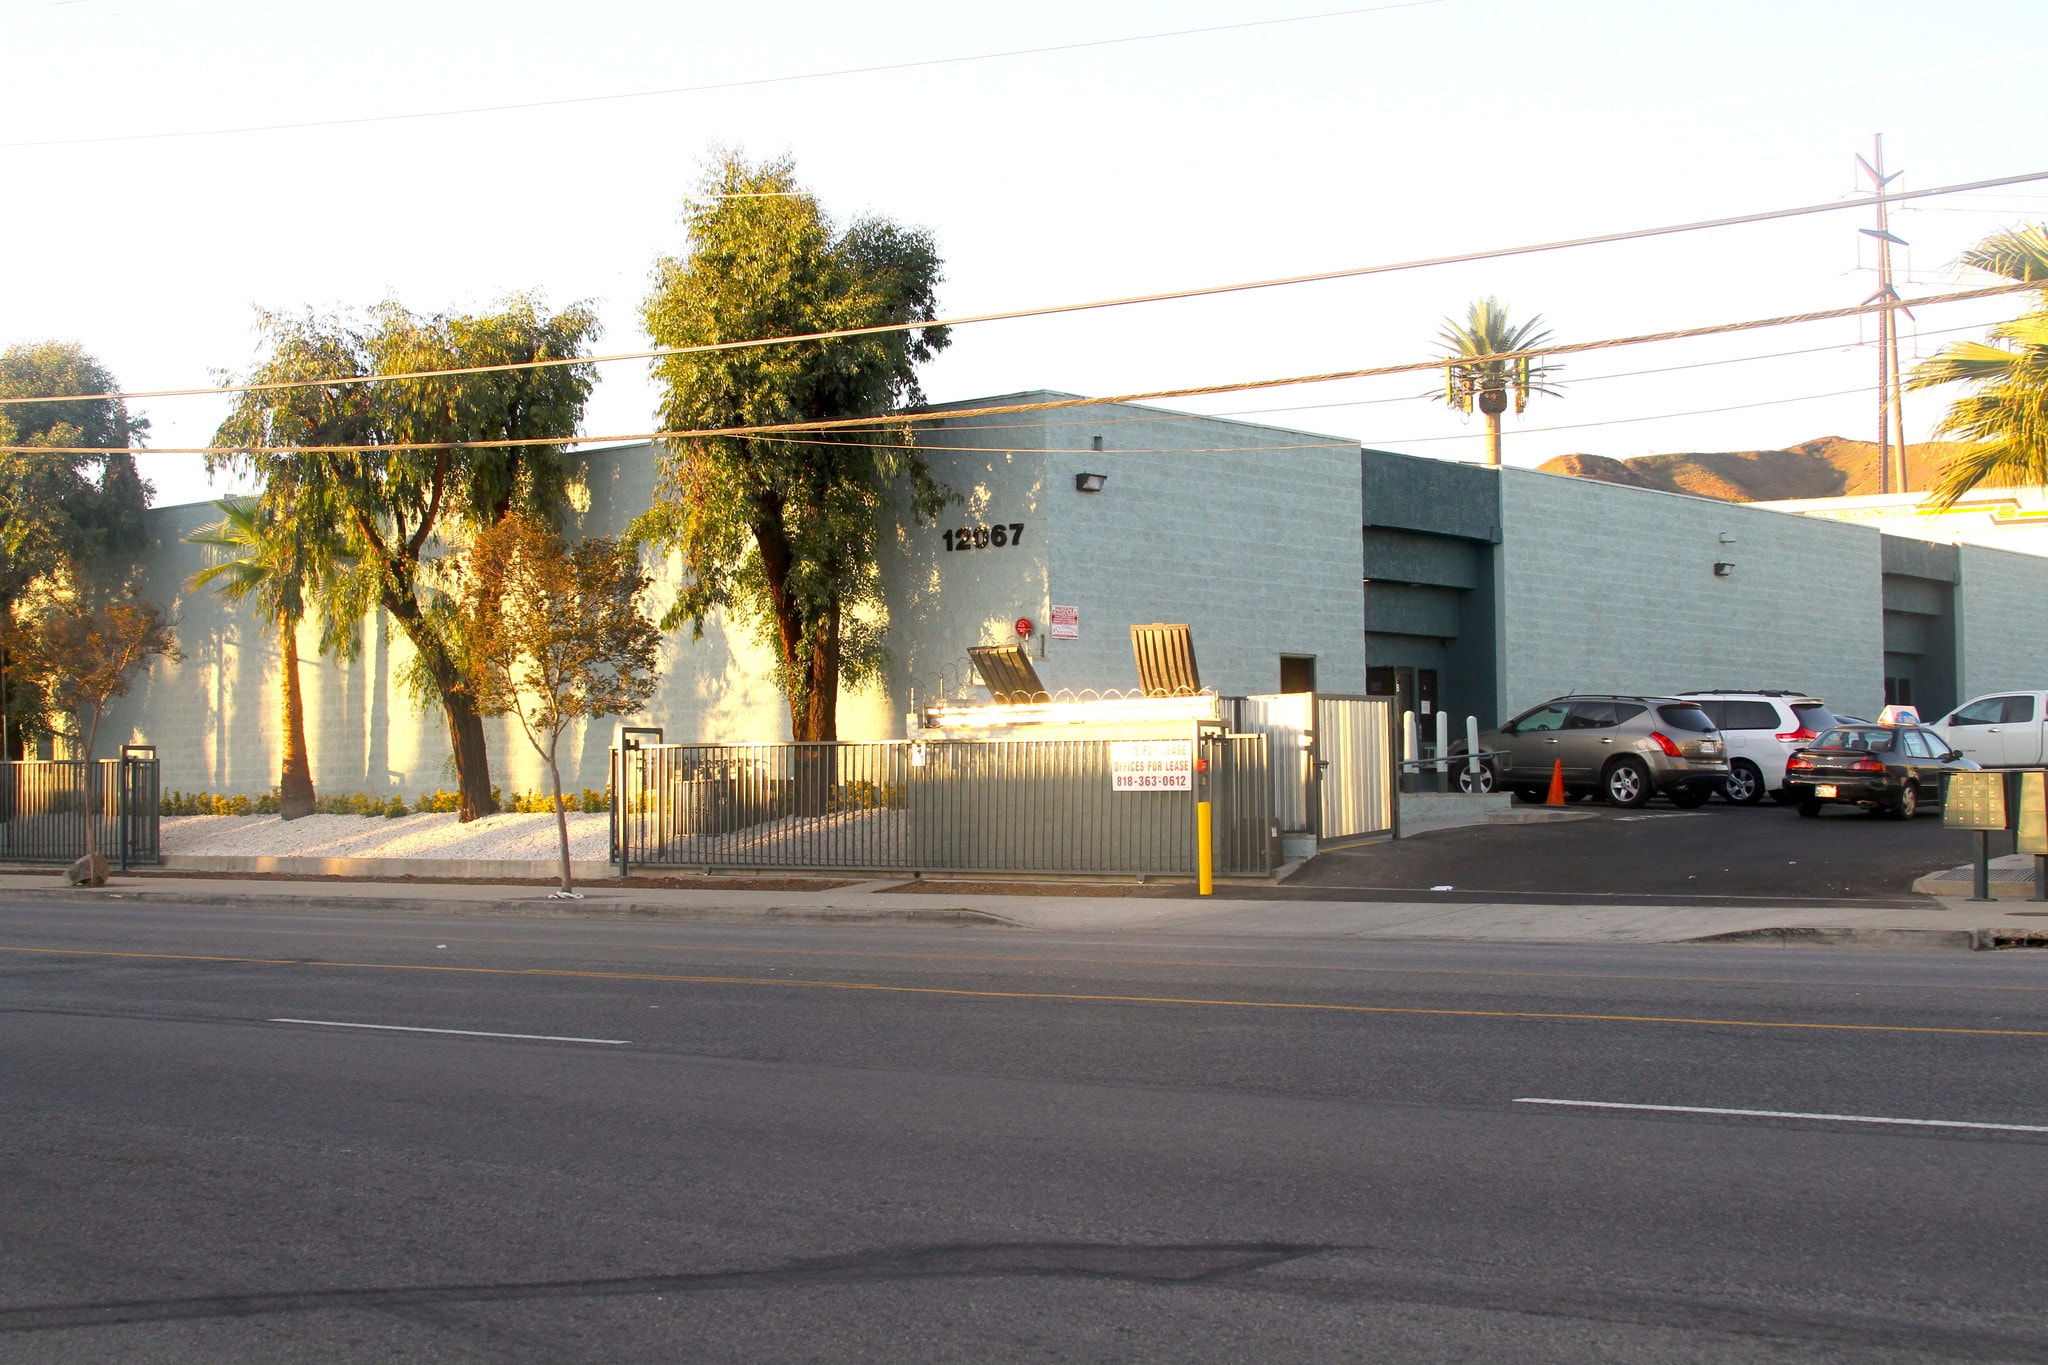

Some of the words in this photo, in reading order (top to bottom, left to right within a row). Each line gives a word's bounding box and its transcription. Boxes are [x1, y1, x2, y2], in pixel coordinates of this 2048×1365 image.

[942, 523, 1025, 552] 12067
[1114, 761, 1144, 772] OFFICES
[1147, 761, 1163, 772] FOR
[1165, 760, 1189, 772] LEASE
[1116, 775, 1187, 787] 818-363-0612
